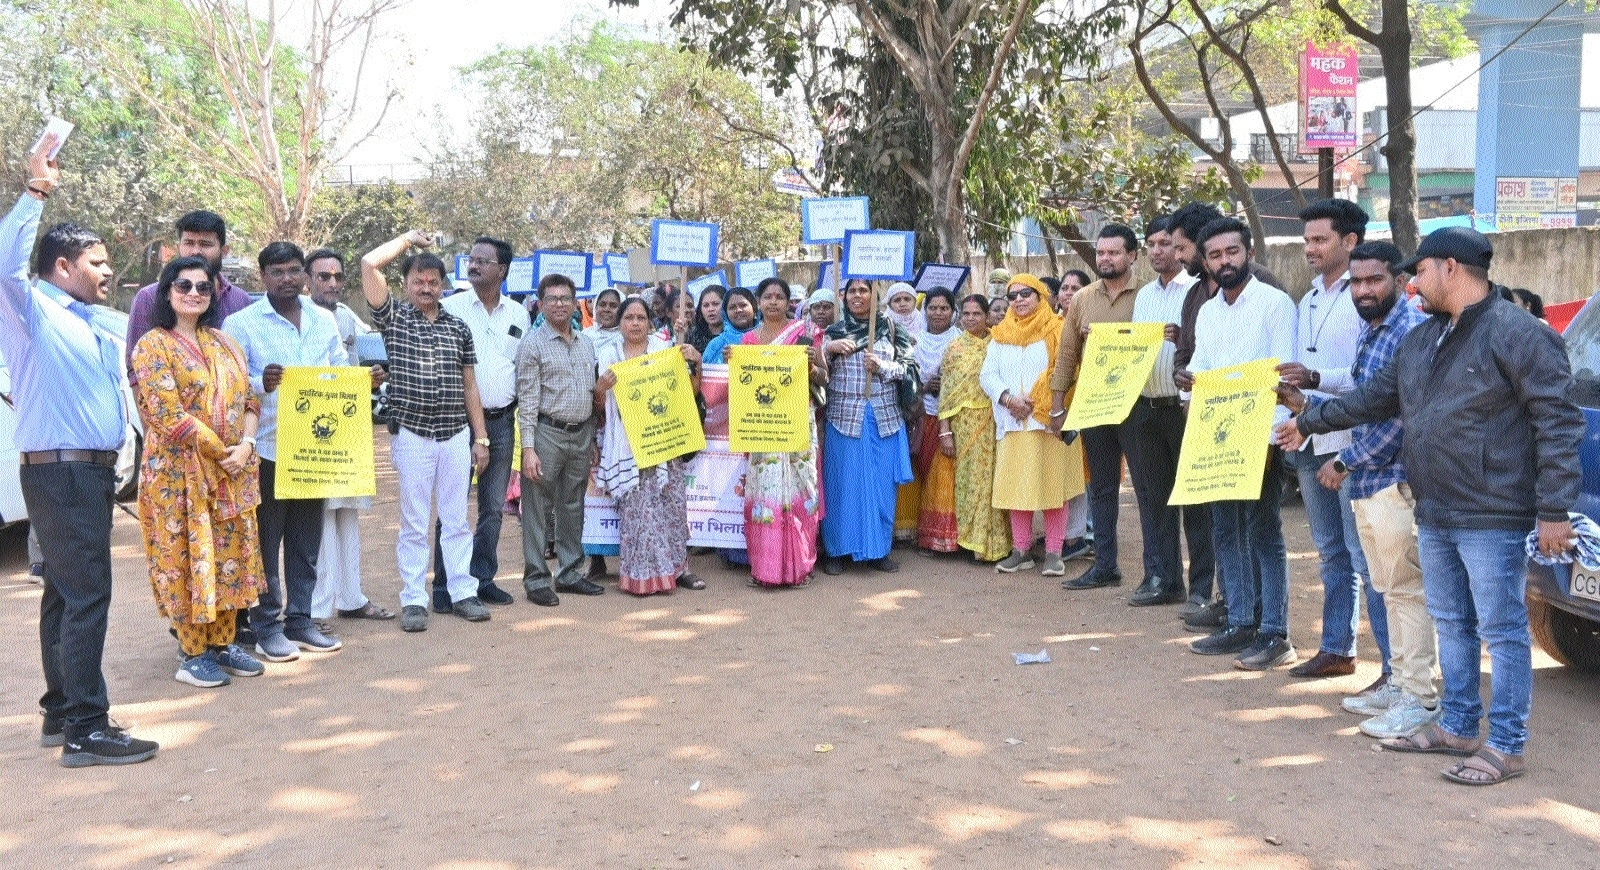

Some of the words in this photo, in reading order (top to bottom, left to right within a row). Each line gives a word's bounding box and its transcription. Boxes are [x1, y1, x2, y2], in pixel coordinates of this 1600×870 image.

[1310, 58, 1346, 72] महक
[1498, 181, 1526, 198] प्रकाश
[740, 364, 762, 372] प्लास्टिक
[776, 365, 792, 373] भिलाई
[299, 389, 323, 398] प्लास्टिक
[339, 390, 357, 400] भिलाई
[1204, 396, 1228, 405] प्लास्टिक
[600, 519, 621, 529] नग
[1575, 574, 1600, 596] CG
